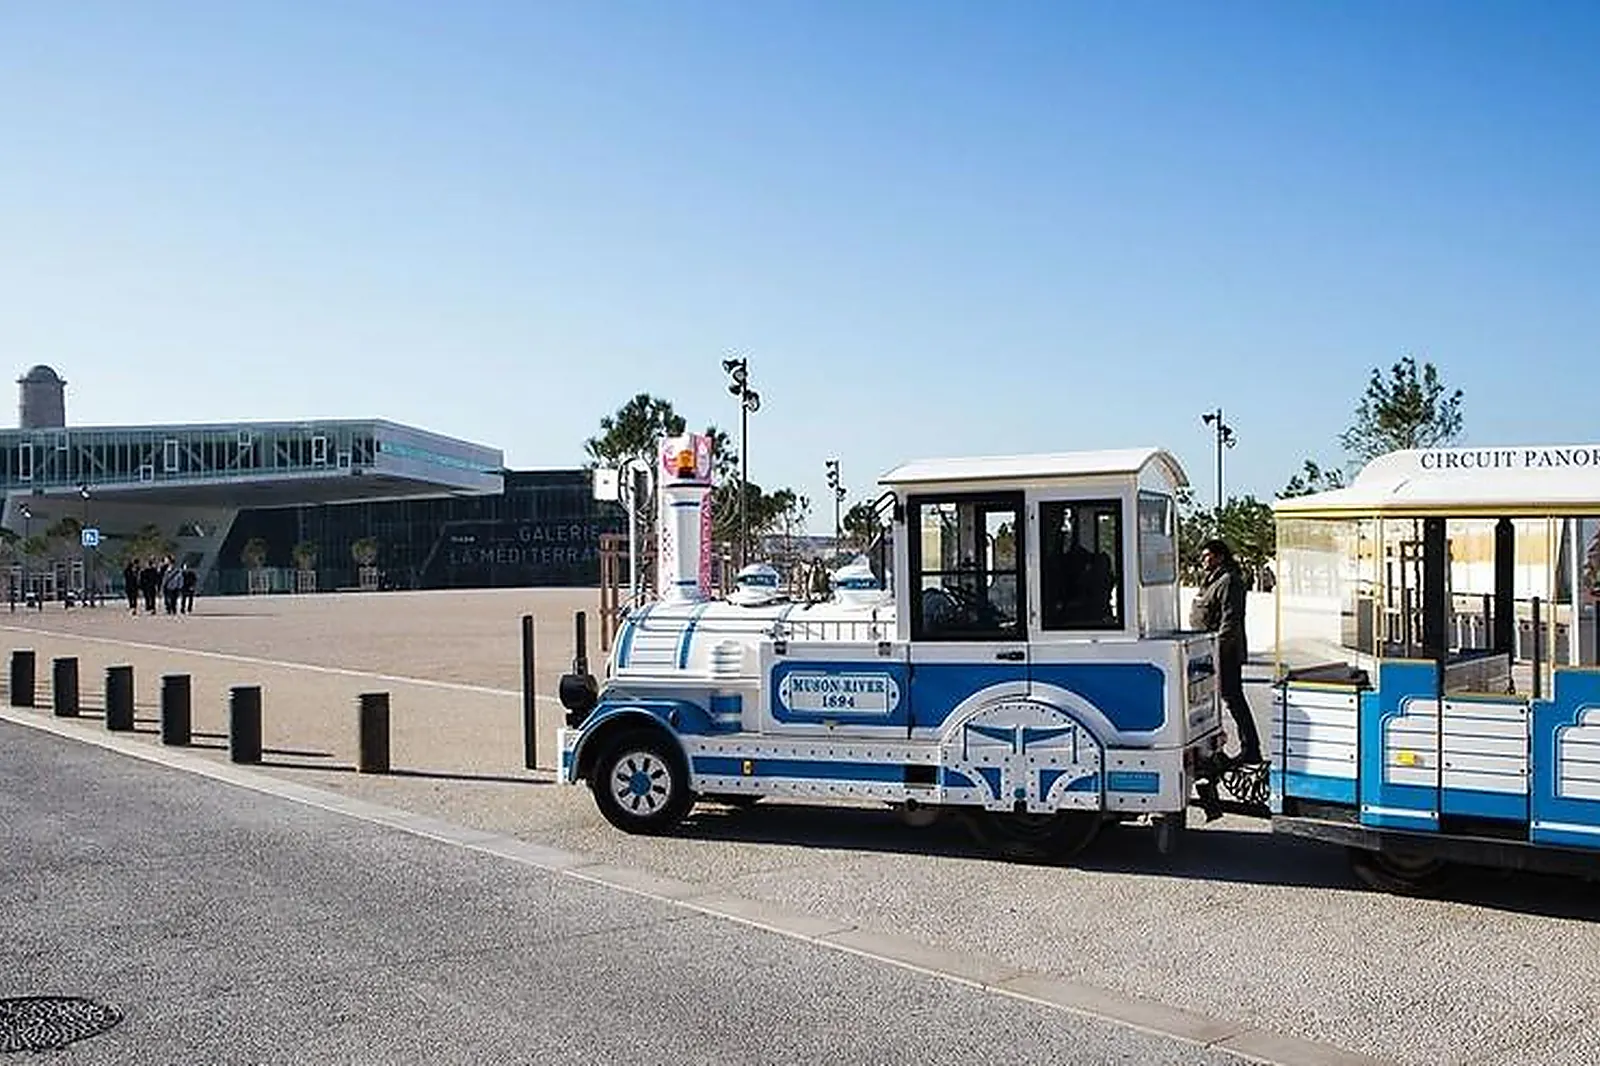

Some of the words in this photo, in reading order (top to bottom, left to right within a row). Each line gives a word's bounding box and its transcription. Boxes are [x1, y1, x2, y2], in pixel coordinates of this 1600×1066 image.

[1420, 451, 1516, 469] CIRCUIT
[519, 525, 599, 542] GALERIE
[792, 678, 839, 693] MUSON
[843, 679, 885, 693] RIVER
[822, 695, 855, 708] 1894
